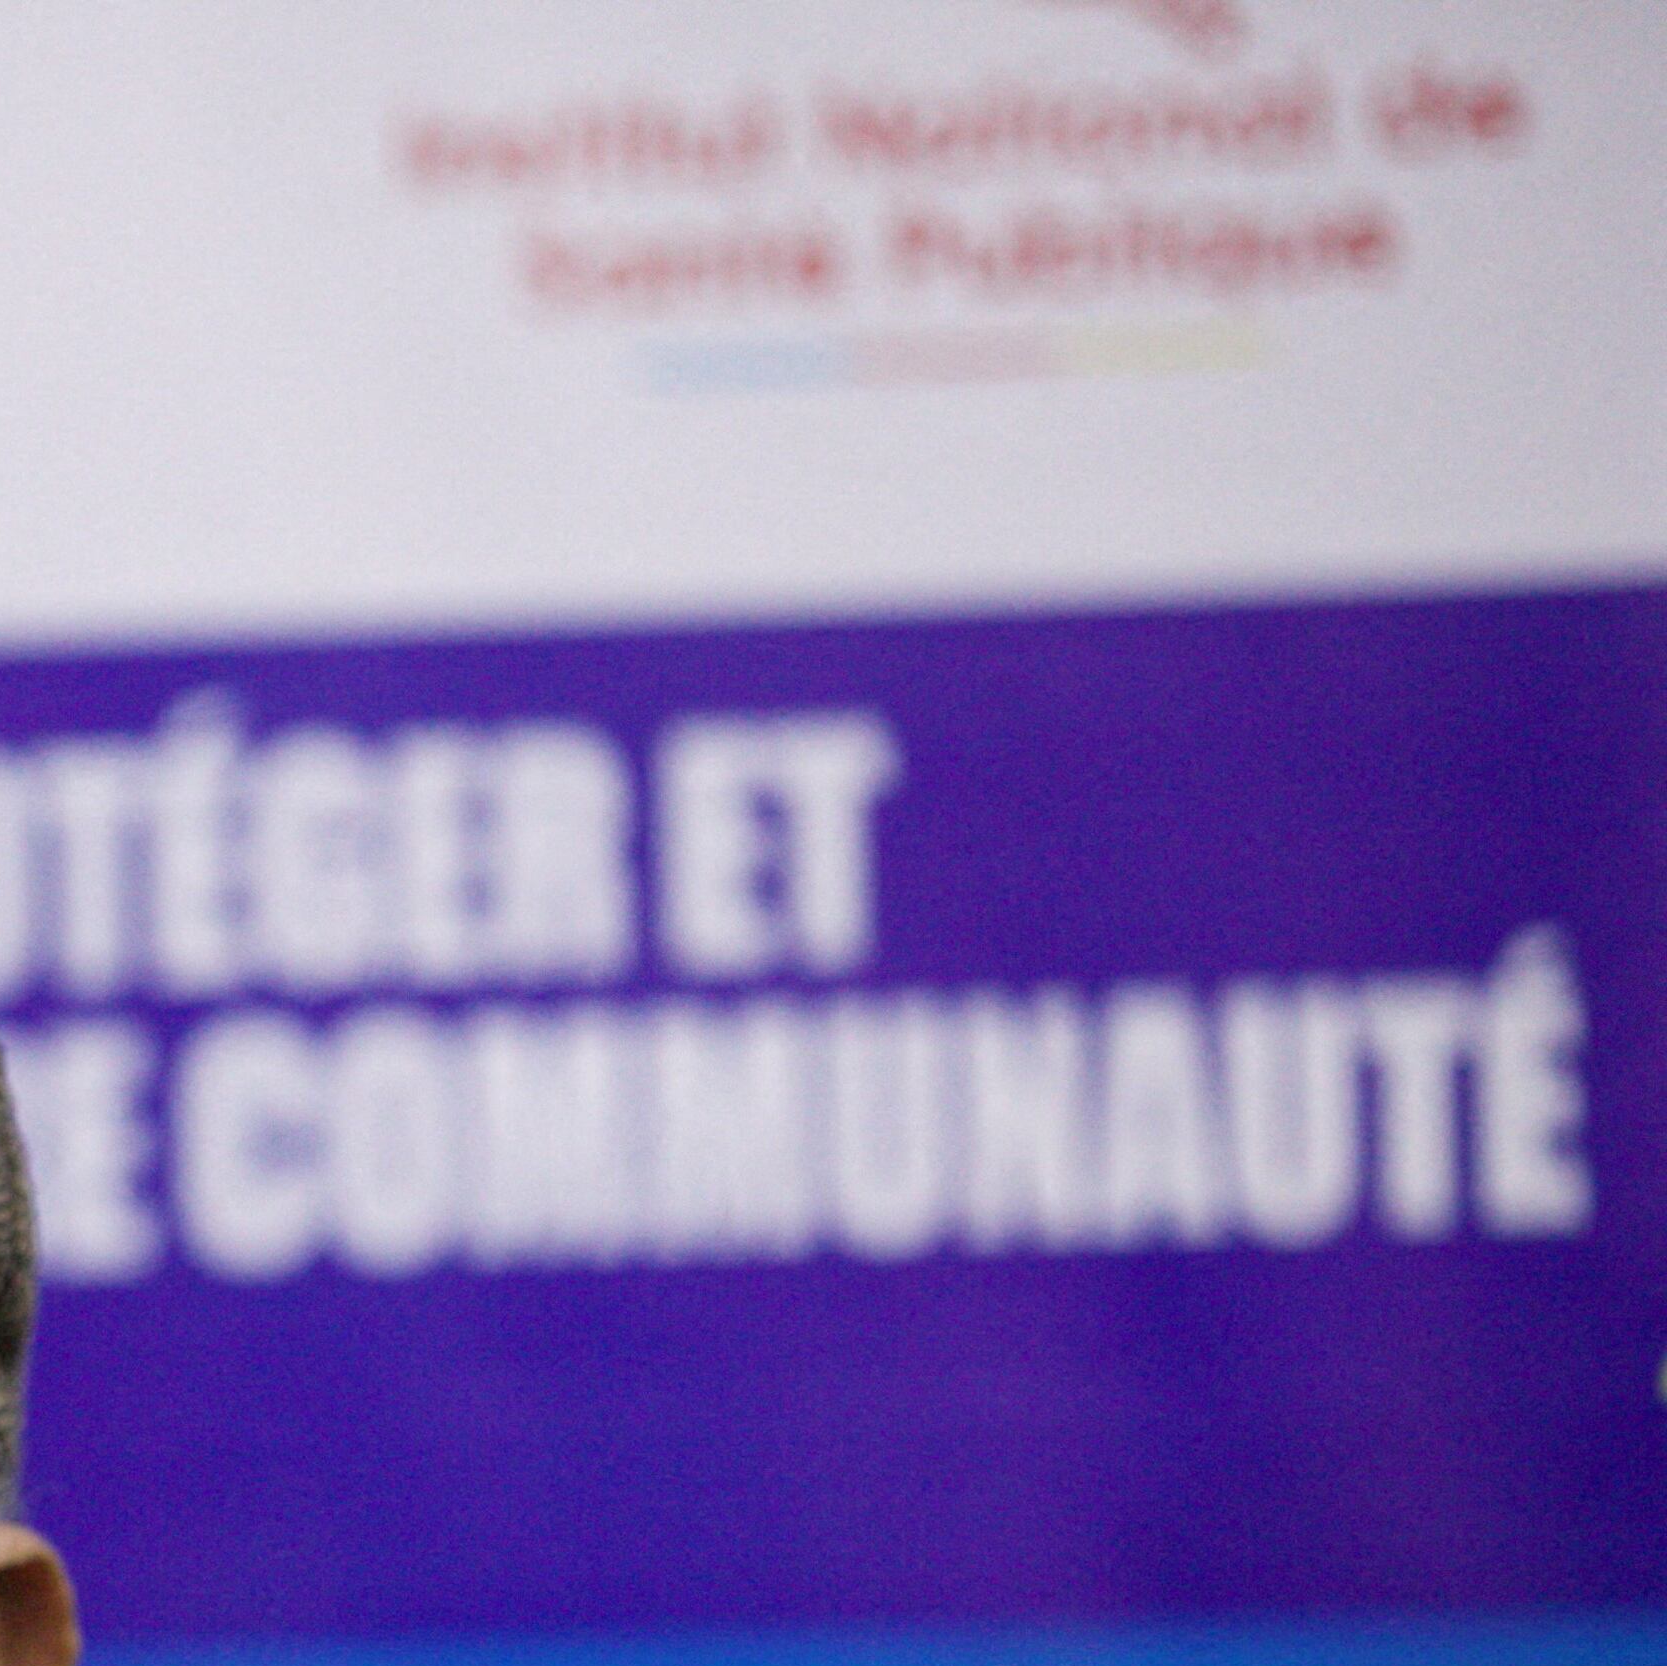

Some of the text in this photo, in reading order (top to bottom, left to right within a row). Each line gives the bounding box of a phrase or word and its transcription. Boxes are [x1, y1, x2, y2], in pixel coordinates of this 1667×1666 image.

[809, 66, 1331, 178] National
[1365, 54, 1533, 164] de
[887, 195, 1407, 300] Publique
[665, 708, 903, 986] ET
[173, 925, 1593, 1286] COMMUNAUTÉ
